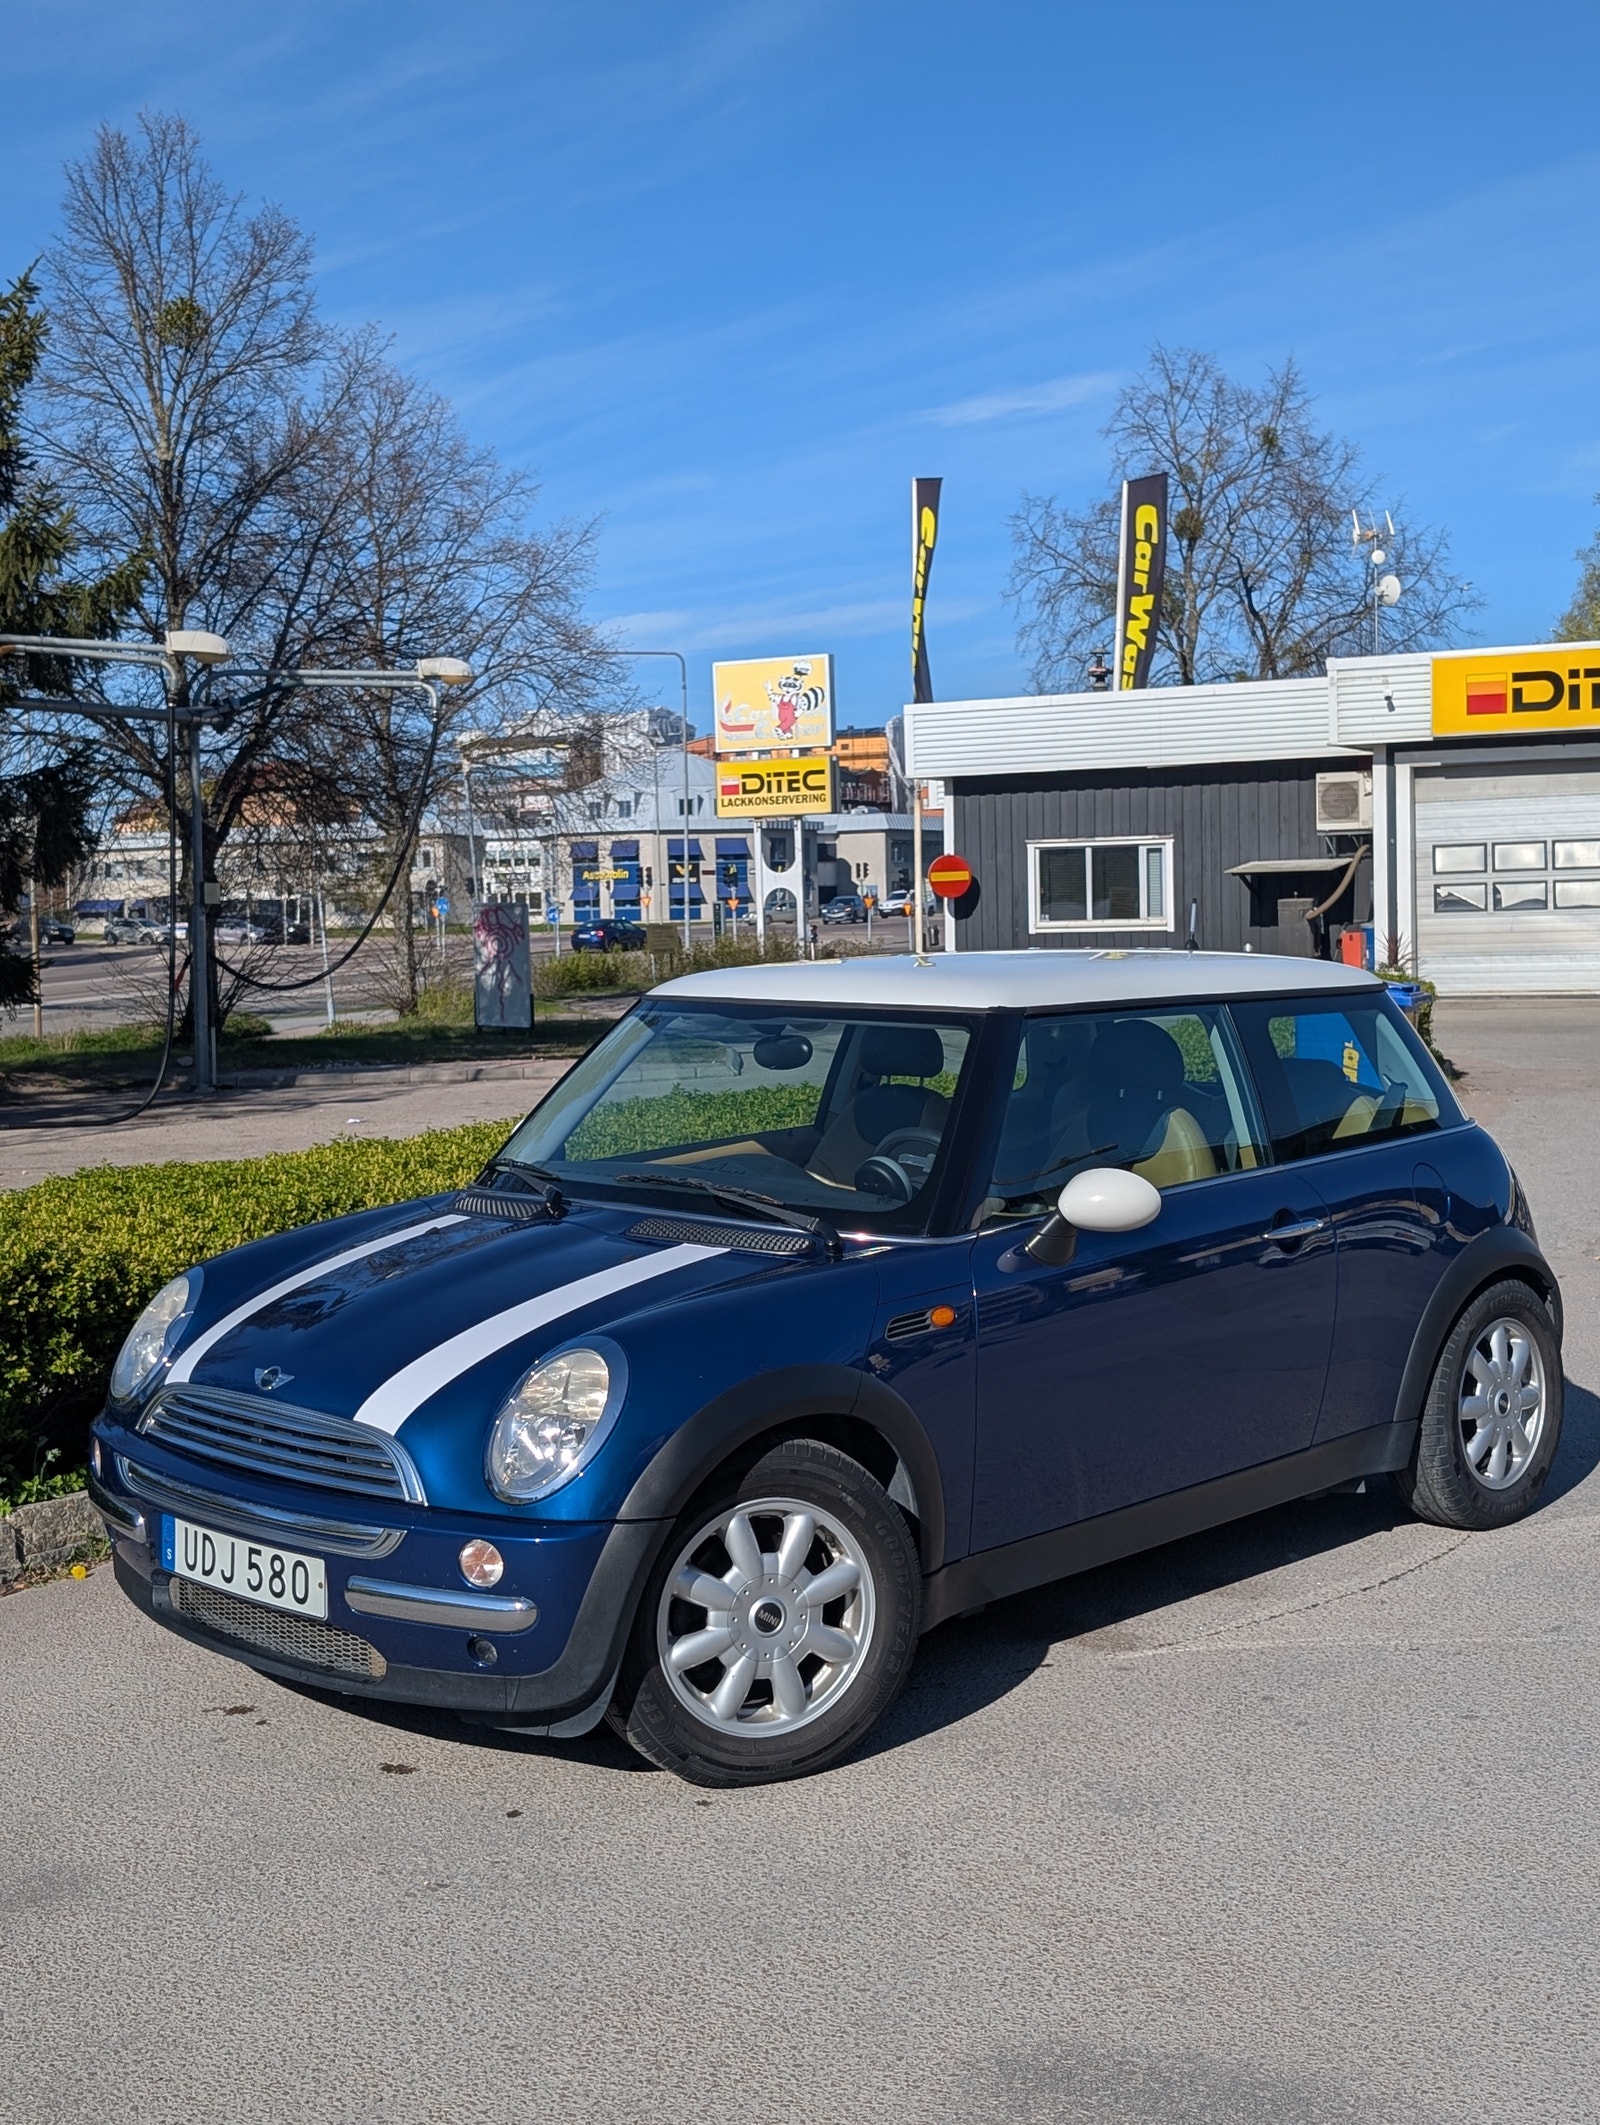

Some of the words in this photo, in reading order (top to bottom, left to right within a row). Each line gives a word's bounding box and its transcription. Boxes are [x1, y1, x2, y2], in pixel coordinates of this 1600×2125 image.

[721, 793, 827, 808] LACKKONSERVERING
[166, 1548, 172, 1560] S
[183, 1525, 236, 1584] UDJ
[246, 1547, 310, 1605] 580
[874, 1519, 910, 1674] GOODYEAR
[758, 1609, 780, 1627] MINI
